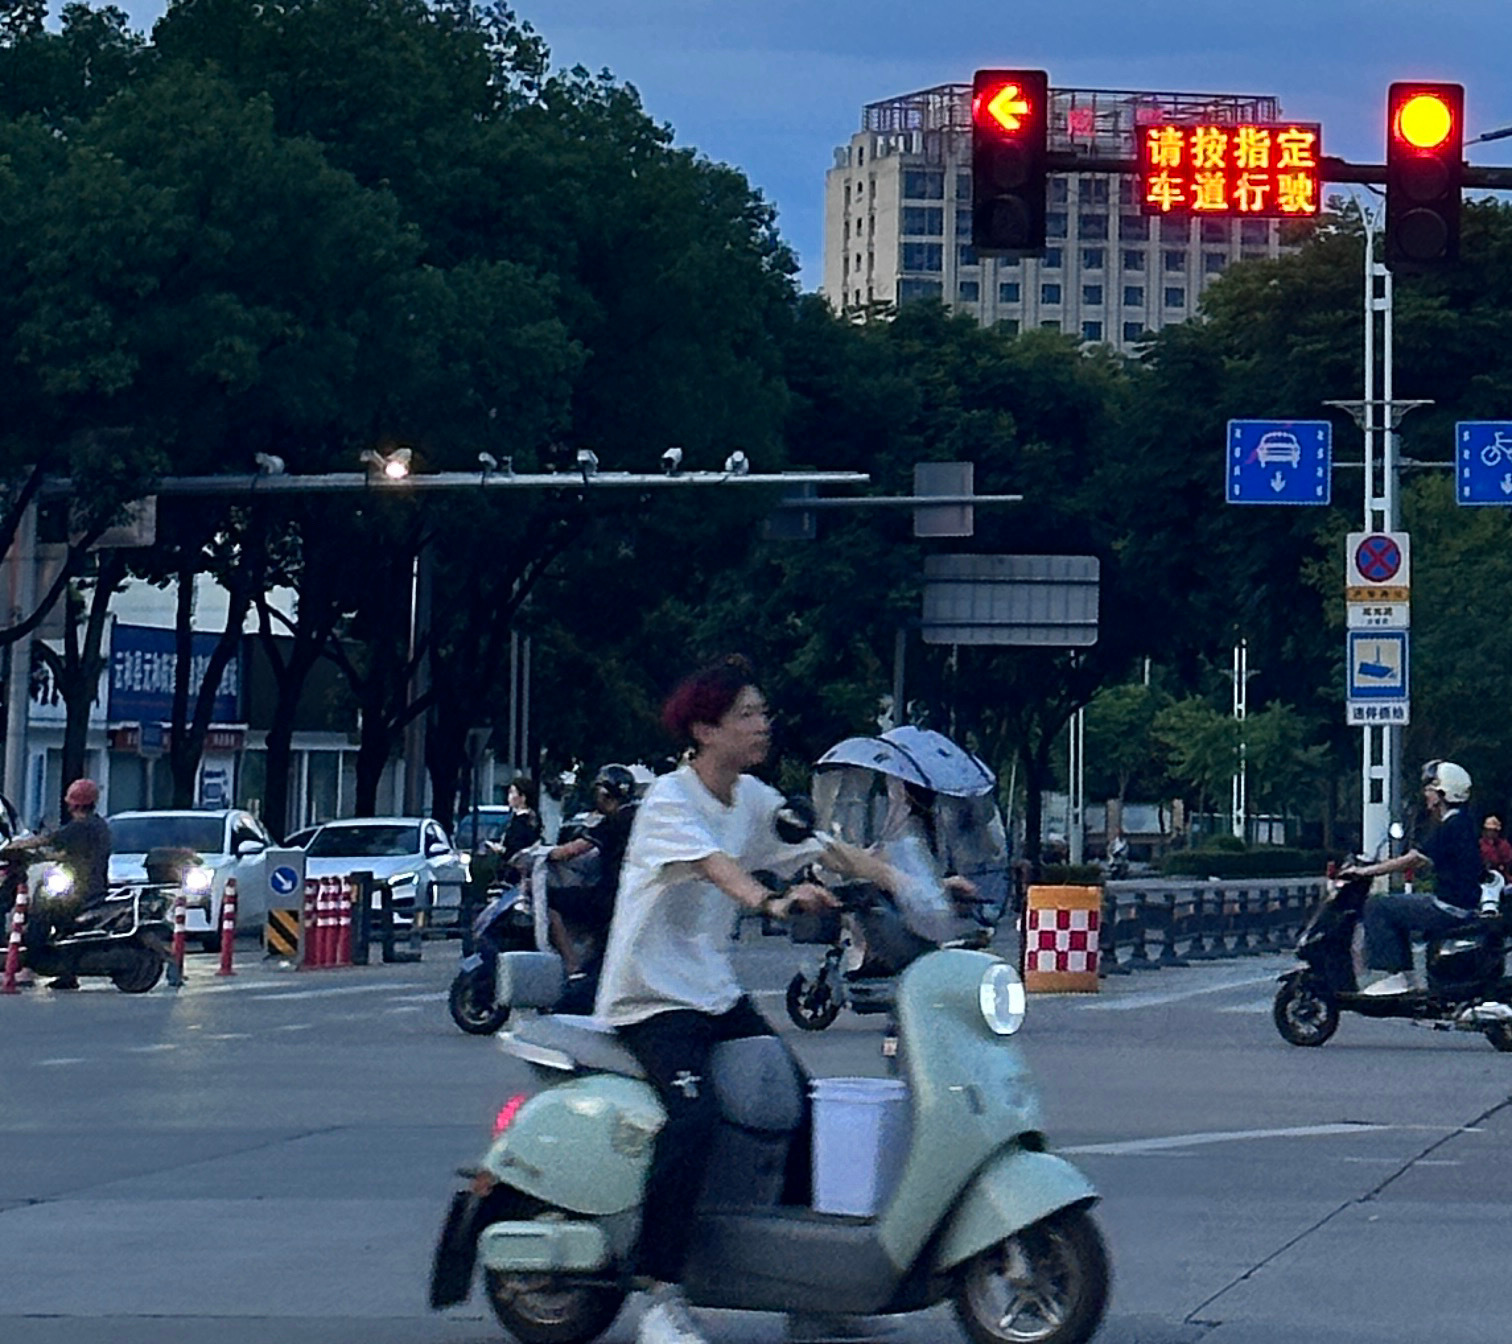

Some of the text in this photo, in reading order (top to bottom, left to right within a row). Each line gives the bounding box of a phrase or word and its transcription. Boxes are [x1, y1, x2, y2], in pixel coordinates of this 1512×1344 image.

[1147, 126, 1316, 168] 请按指定
[1147, 170, 1316, 212] 车道行驶
